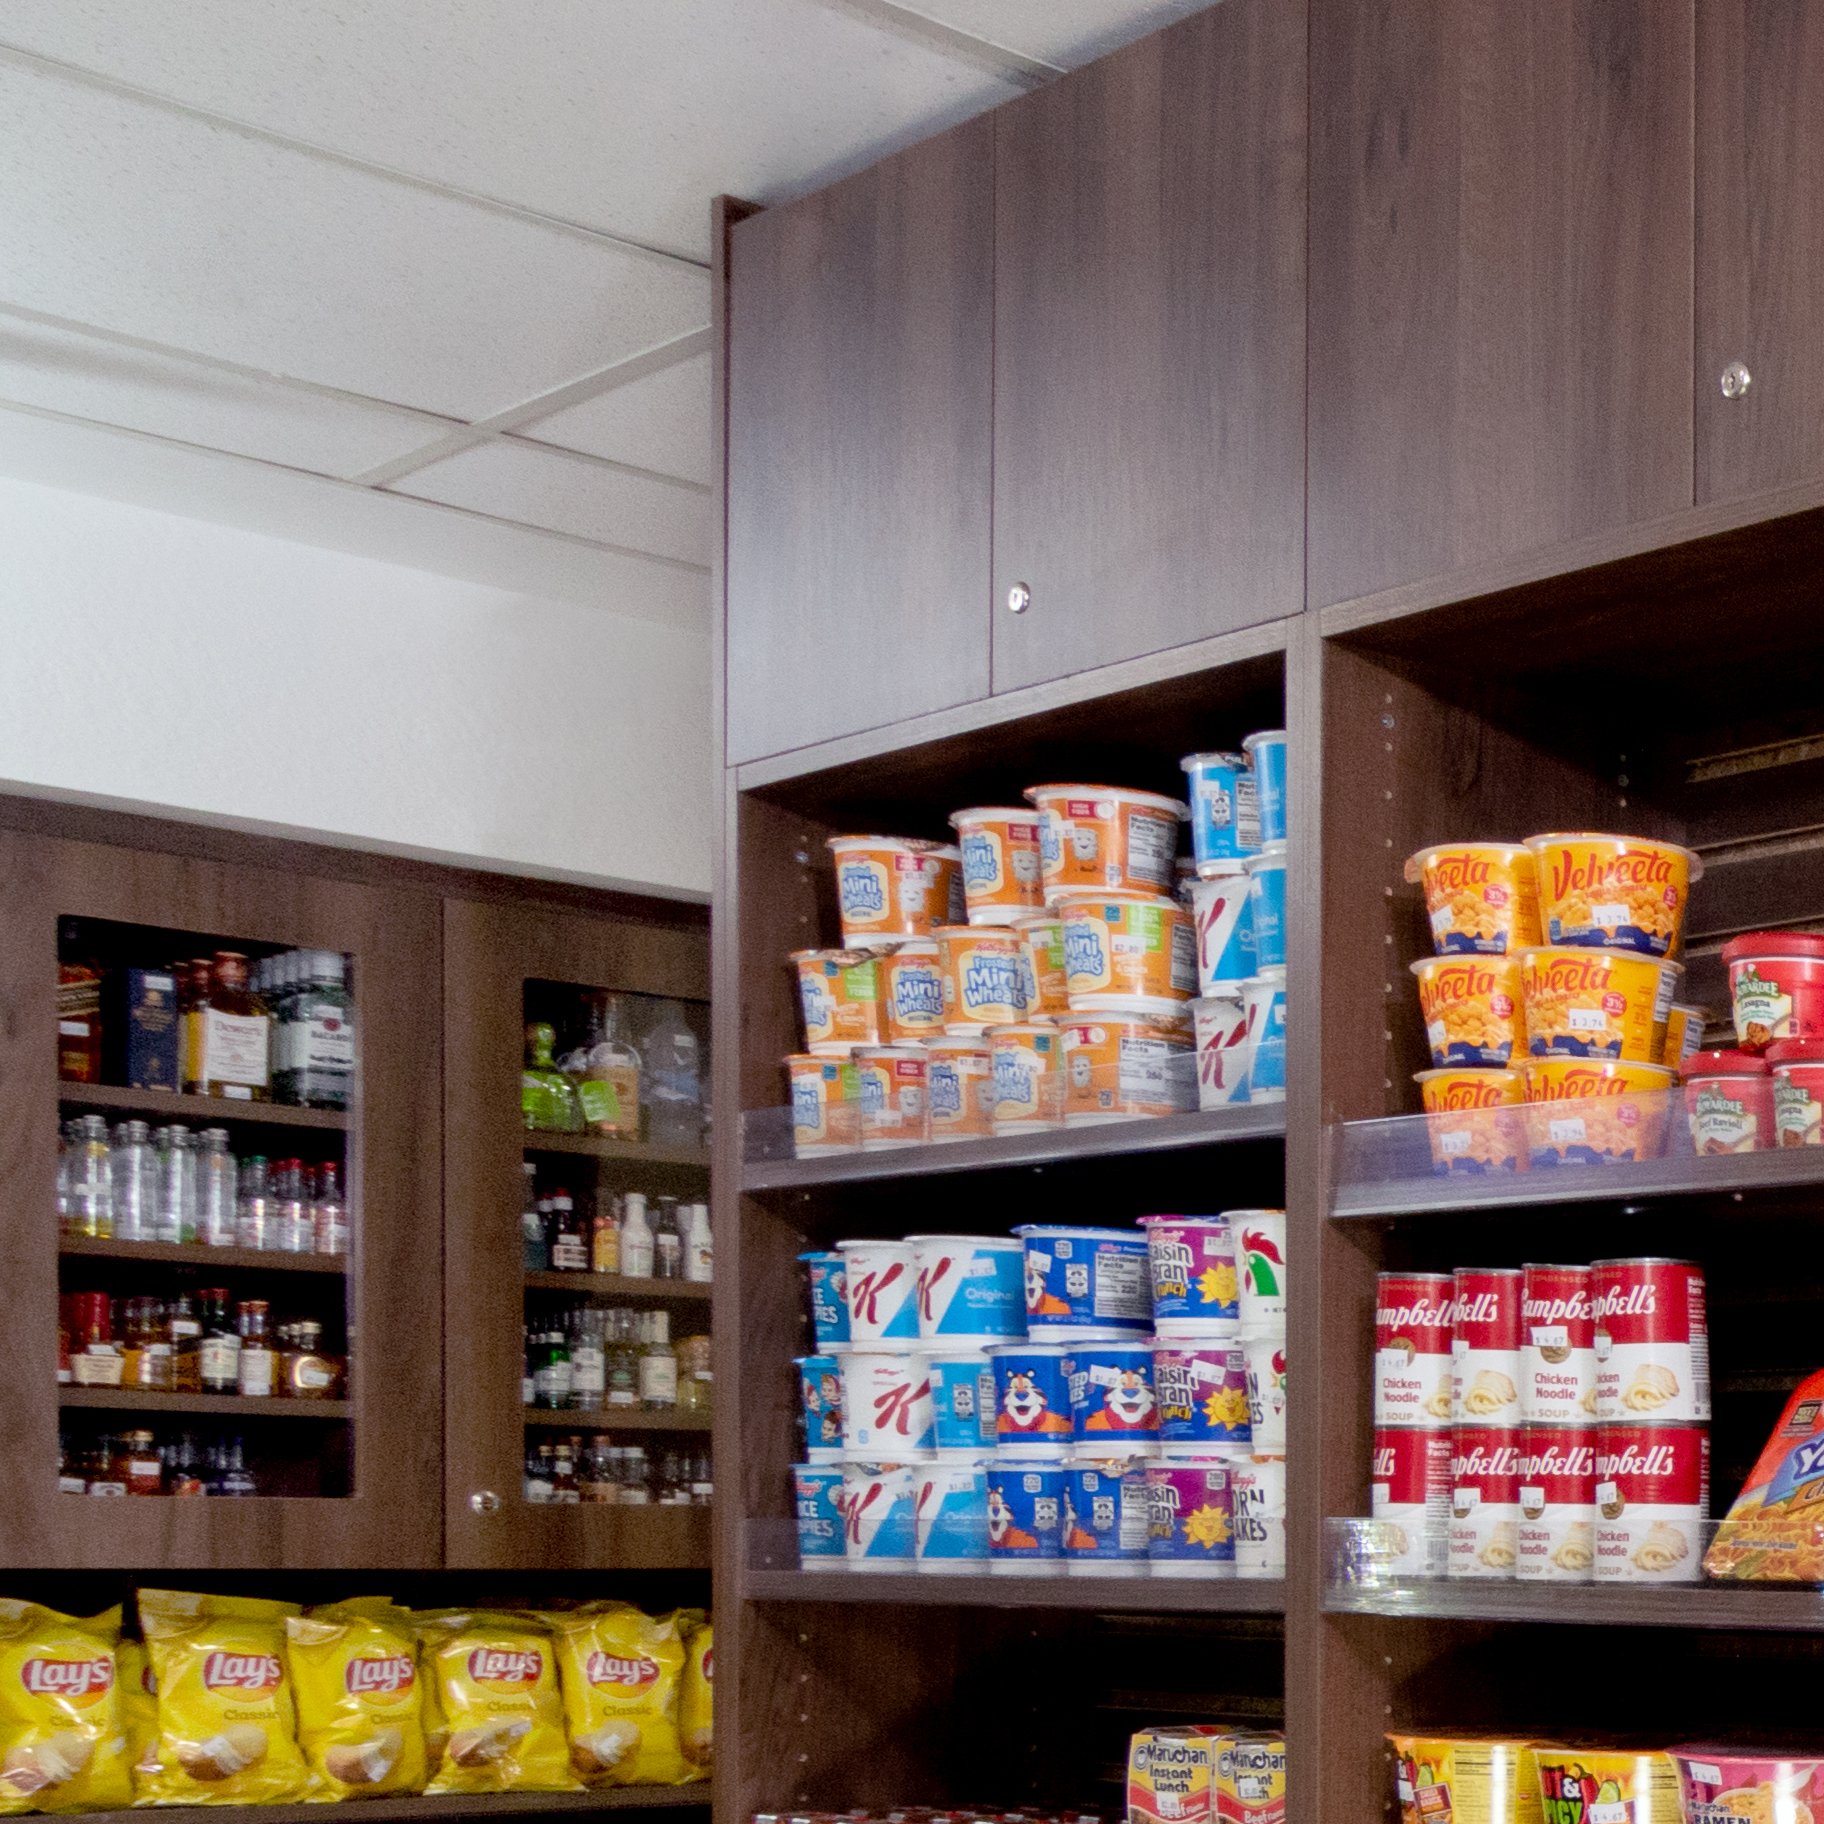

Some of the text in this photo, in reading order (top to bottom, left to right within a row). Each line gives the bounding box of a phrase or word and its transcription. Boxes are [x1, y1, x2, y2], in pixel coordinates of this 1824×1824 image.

[1553, 849, 1674, 901] Velveeta
[974, 957, 1015, 969] Frosted
[968, 967, 1016, 988] Mini
[967, 987, 1027, 1007] Wheats
[853, 1263, 904, 1324] K
[1534, 1373, 1578, 1385] Chicken
[1536, 1388, 1575, 1400] Noodle
[1538, 1409, 1570, 1418] SOUP
[26, 1657, 110, 1695] Lay's
[207, 1653, 280, 1688] Lay's
[592, 1651, 658, 1683] Lay's
